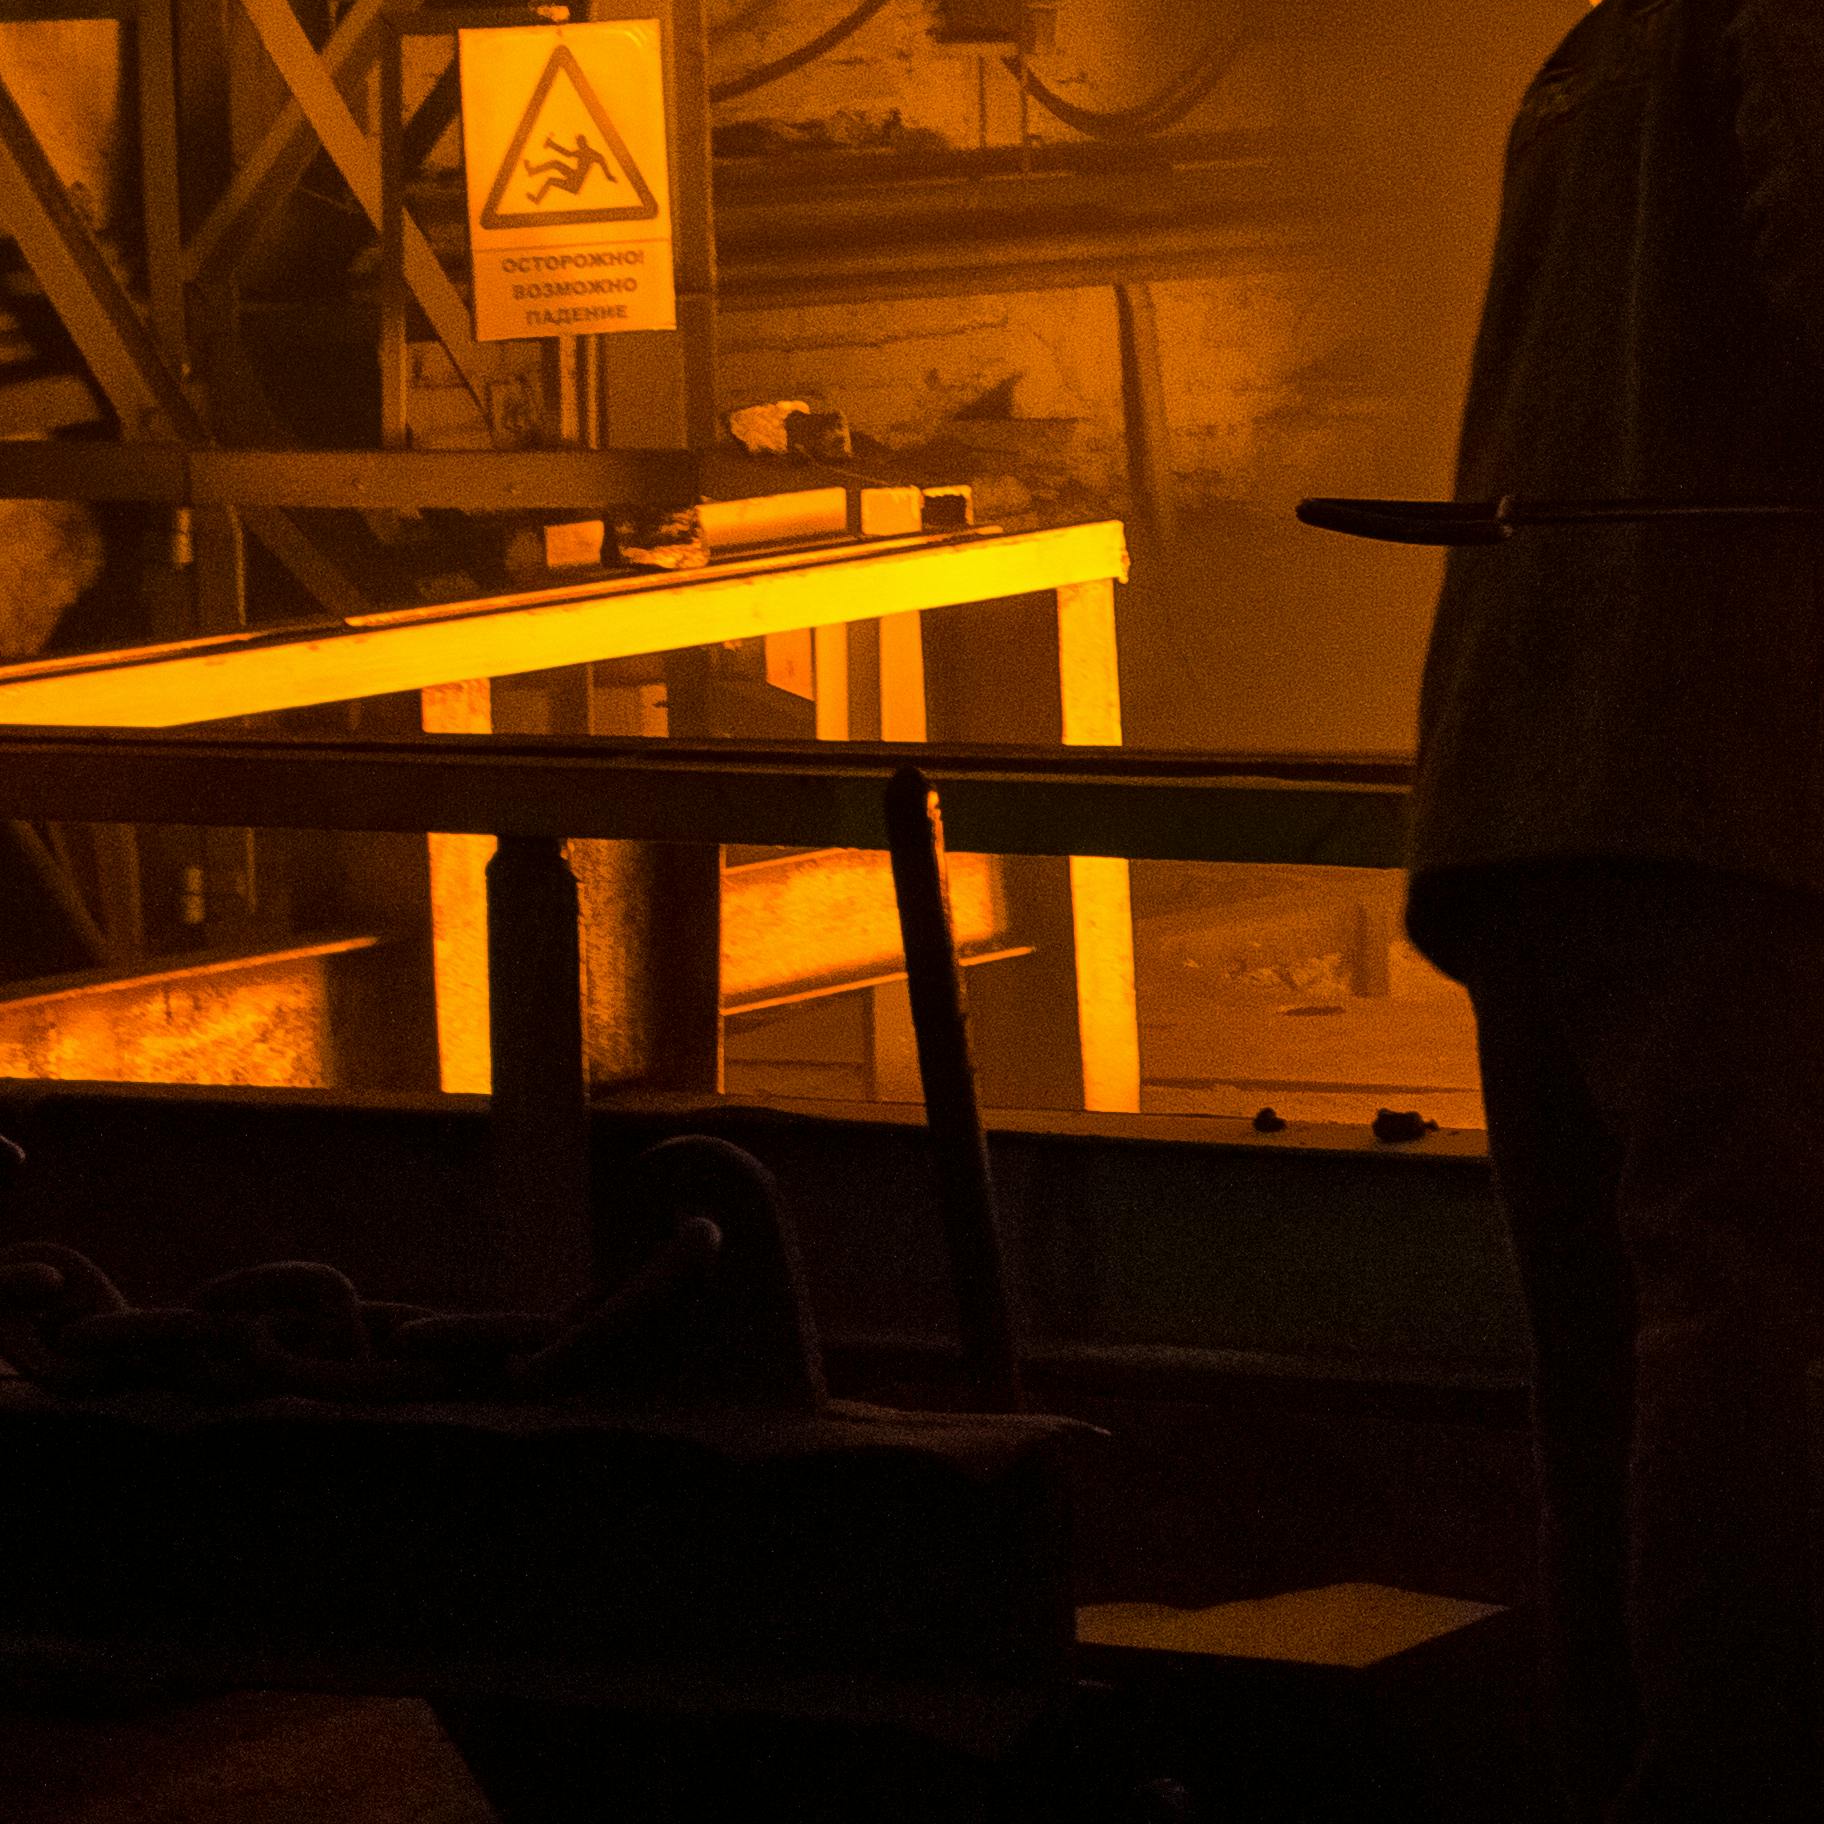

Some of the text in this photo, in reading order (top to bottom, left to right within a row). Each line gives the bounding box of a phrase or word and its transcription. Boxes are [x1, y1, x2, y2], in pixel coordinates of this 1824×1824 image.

[501, 250, 645, 274] ОСТОРОЖНО!
[512, 277, 638, 300] ВОЗМОЖНО
[526, 304, 629, 326] ПАДЕНИЕ
